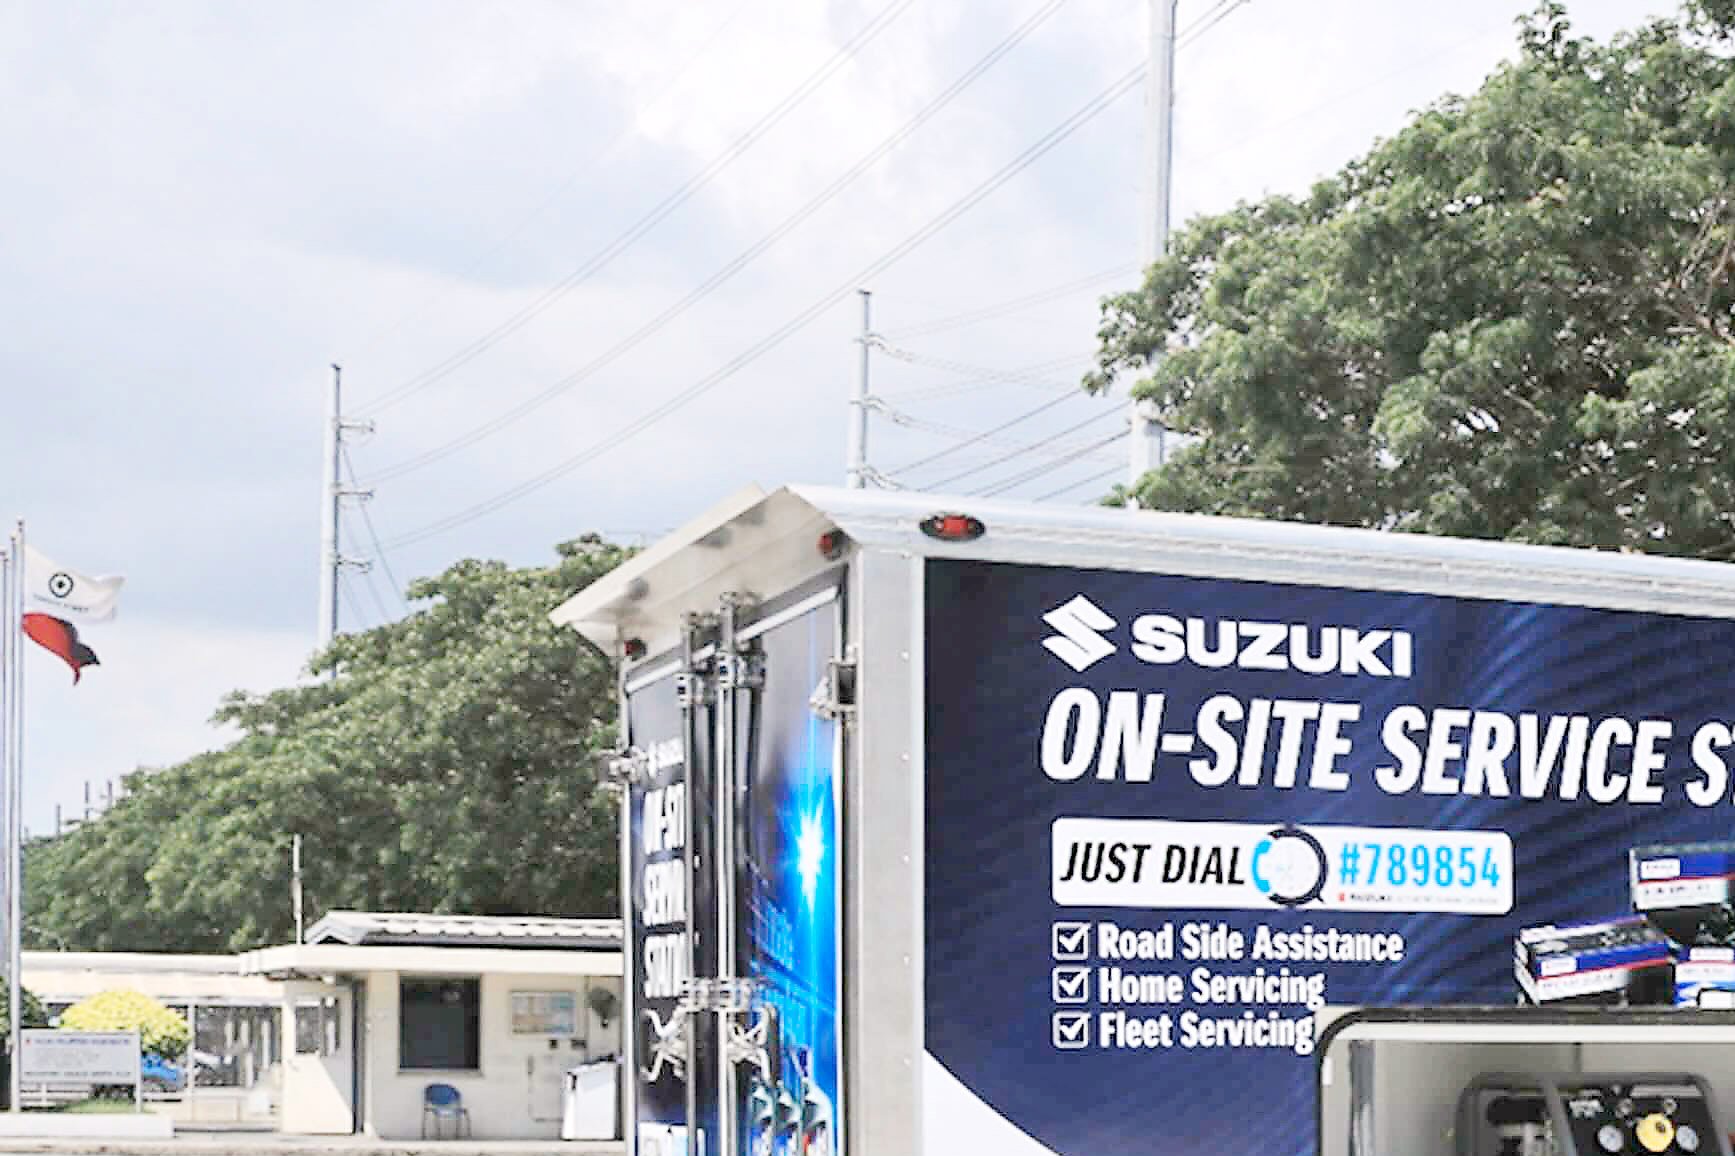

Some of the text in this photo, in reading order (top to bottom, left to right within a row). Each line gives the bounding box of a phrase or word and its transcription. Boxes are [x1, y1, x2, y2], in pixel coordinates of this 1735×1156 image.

[1131, 613, 1412, 678] SUZUKI
[1040, 687, 1361, 790] ON-SITE
[1374, 705, 1673, 803] SERVICE
[1059, 842, 1500, 888] JUST DIAL #789854
[1097, 922, 1404, 962] Road Side Assistance
[1098, 966, 1326, 1011] Home Servicing
[1098, 1010, 1315, 1055] Fleet Servicing
